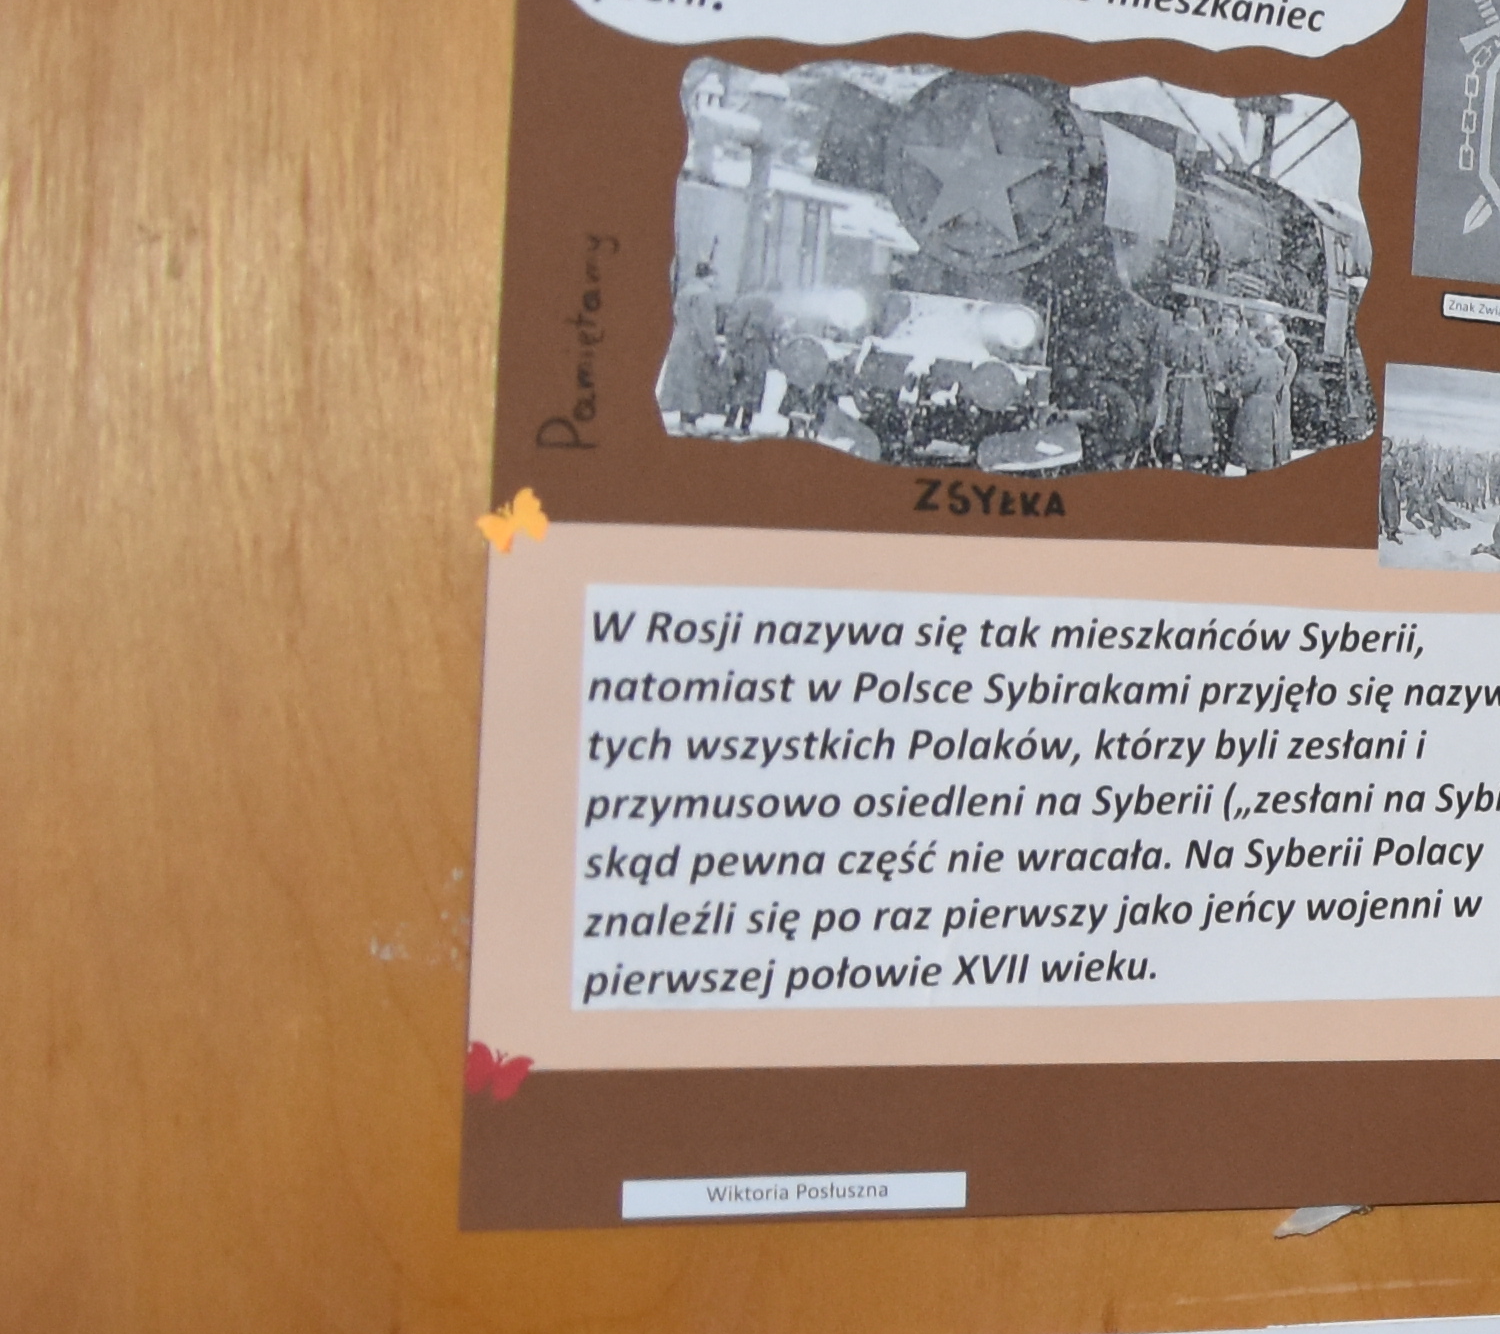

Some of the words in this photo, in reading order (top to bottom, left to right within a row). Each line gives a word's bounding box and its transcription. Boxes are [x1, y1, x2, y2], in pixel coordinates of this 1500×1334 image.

[1448, 299, 1475, 314] Znak
[913, 478, 1066, 517] ZSYŁKA
[593, 611, 636, 643] W
[646, 611, 744, 652] Rosji
[753, 620, 904, 654] nazywa
[914, 615, 968, 655] się
[980, 616, 1041, 648] tak
[1050, 617, 1291, 652] mieszkańców
[1298, 621, 1424, 660] Syberii,
[584, 793, 841, 828] przymusowo
[853, 784, 1026, 818] osiedleni
[1035, 792, 1082, 817] na
[1091, 783, 1214, 824] Syberii
[1223, 781, 1375, 822] („zesłani
[1383, 790, 1426, 813] na
[582, 958, 776, 1005] pierwszej
[784, 954, 943, 999] połowie
[952, 953, 1030, 986] XVII
[1041, 949, 1157, 983] wieku.
[706, 1184, 789, 1202] Wiktoria
[796, 1182, 888, 1200] Posłuszna
